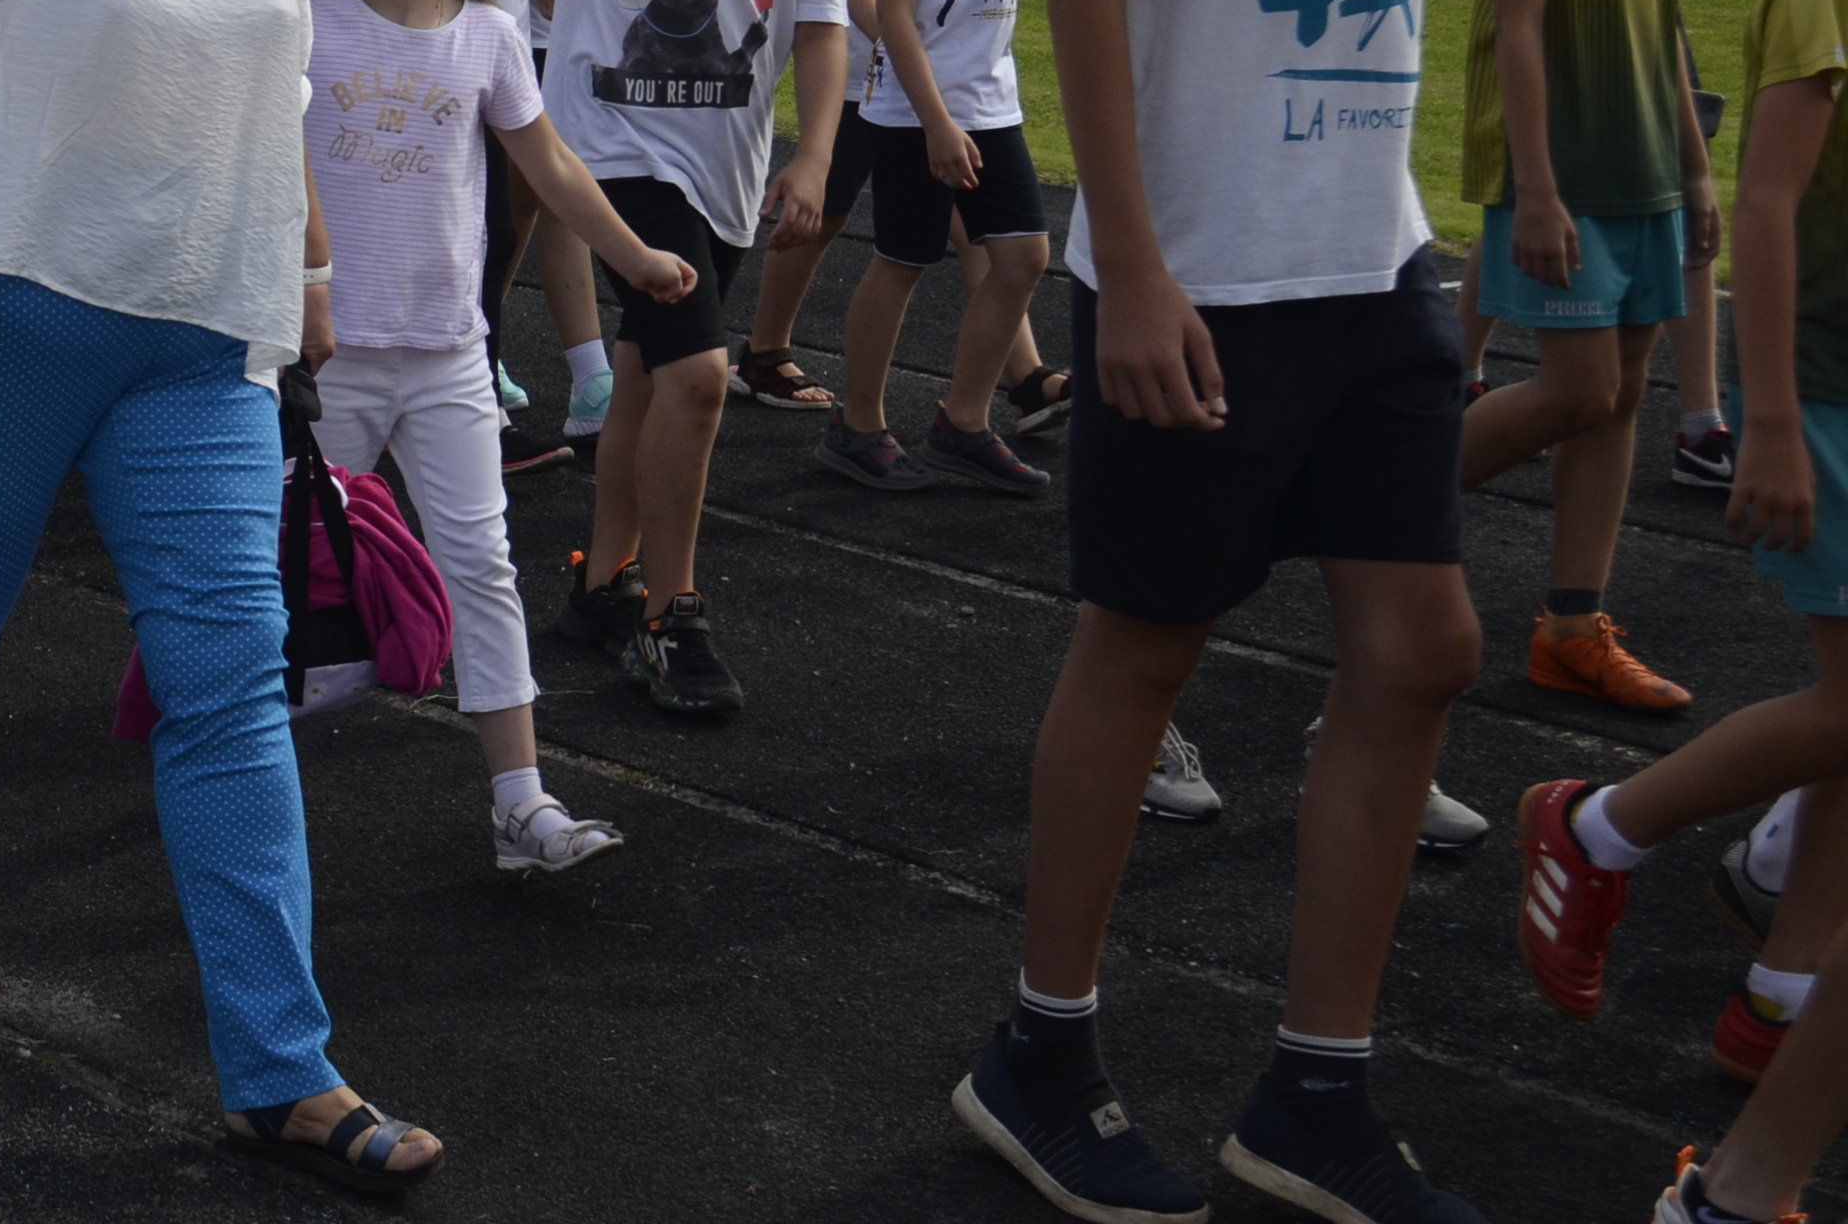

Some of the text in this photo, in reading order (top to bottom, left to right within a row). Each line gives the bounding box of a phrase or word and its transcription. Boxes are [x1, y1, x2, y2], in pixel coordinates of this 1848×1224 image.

[330, 69, 462, 126] BELIEVE
[693, 80, 724, 104] OUT
[376, 105, 407, 133] IN
[1283, 98, 1325, 142] LA
[328, 125, 435, 183] Magic
